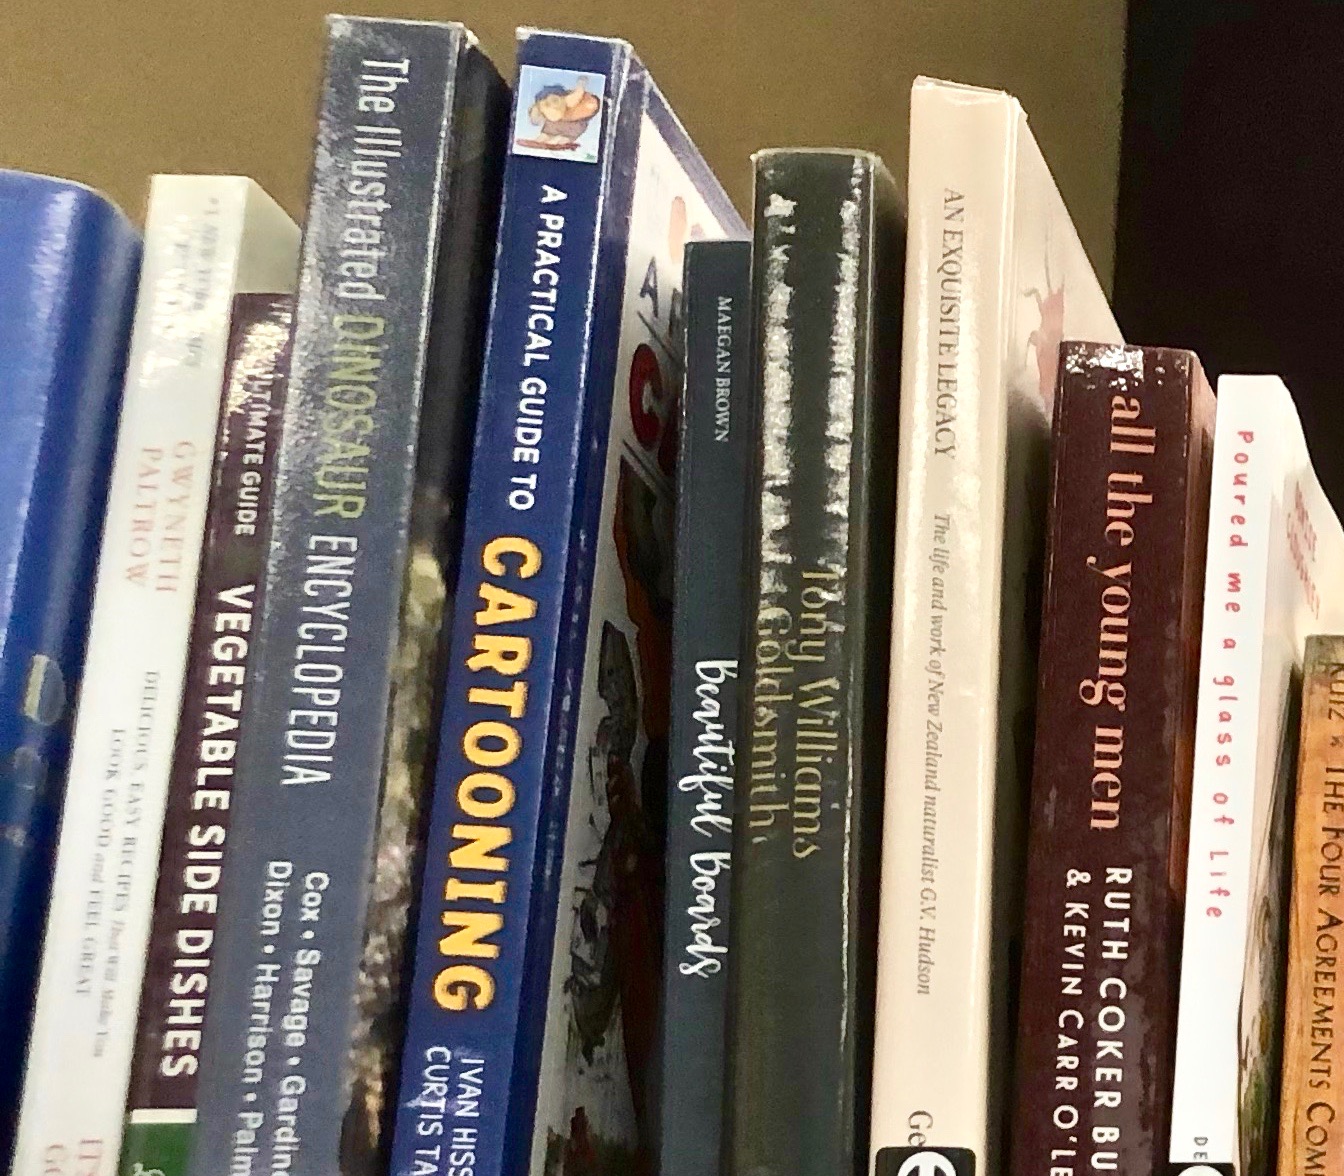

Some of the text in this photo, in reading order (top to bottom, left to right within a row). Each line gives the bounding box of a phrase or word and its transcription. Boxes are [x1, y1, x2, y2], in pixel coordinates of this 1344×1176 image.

[714, 296, 733, 442] MAEGAN BROWN
[934, 188, 964, 460] AN EXQUISITE LEGACY
[280, 58, 410, 785] The Illustrated DINOSAUR ENCYCLOPEDIA
[1229, 431, 1254, 547] Poured
[434, 184, 568, 1012] A PRACTICAL GUIDE TO CARTOONING
[1078, 393, 1157, 831] all the young men
[1225, 572, 1242, 613] me
[1222, 638, 1236, 650] a
[916, 513, 950, 995] The life and work of New Zealand naturalist G.V. Hudson
[1212, 676, 1238, 767] glass
[159, 585, 255, 1078] VEGETABLE SIDE DISHES
[679, 660, 740, 978] beautiful boards
[1212, 792, 1234, 826] of
[260, 861, 293, 936] Dixon
[300, 871, 330, 921] Cox
[1065, 868, 1091, 888] &
[1102, 865, 1132, 961] RUTH
[281, 949, 321, 1047] Savage
[1060, 903, 1089, 995] KEVIN
[241, 963, 281, 1084] Harrison
[1093, 977, 1127, 1108] COKER
[1308, 908, 1344, 1090] AGREEMENTS
[416, 1046, 450, 1136] CURTIS
[454, 1058, 484, 1116] IVAN
[1055, 1008, 1083, 1095] CARR
